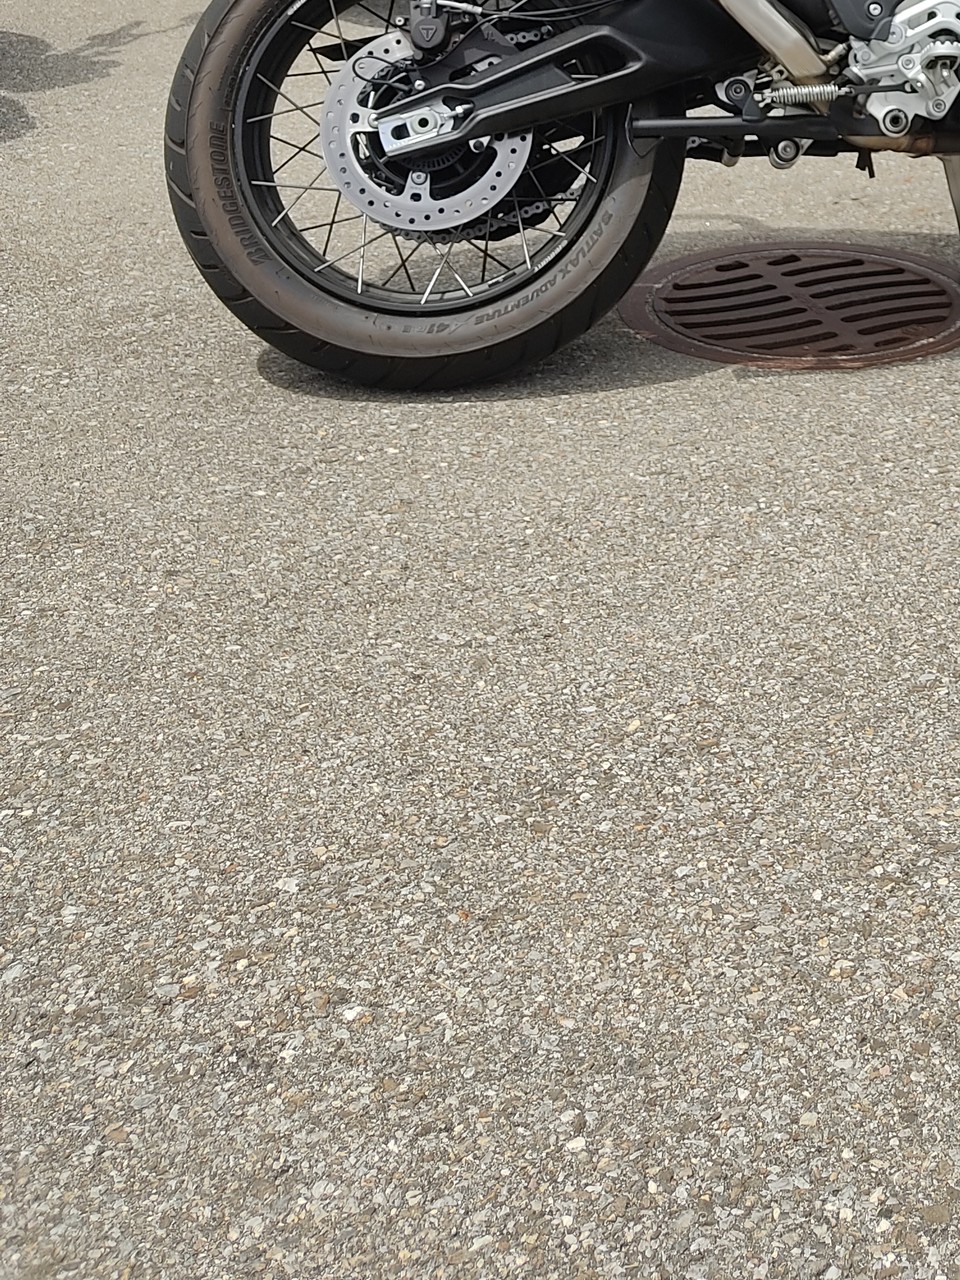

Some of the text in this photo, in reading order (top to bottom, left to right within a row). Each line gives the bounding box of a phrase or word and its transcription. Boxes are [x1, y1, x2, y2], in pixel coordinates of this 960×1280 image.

[209, 120, 269, 266] BRIDGESTONE
[558, 209, 613, 280] BATTLAX
[474, 274, 560, 326] ADVENTURE
